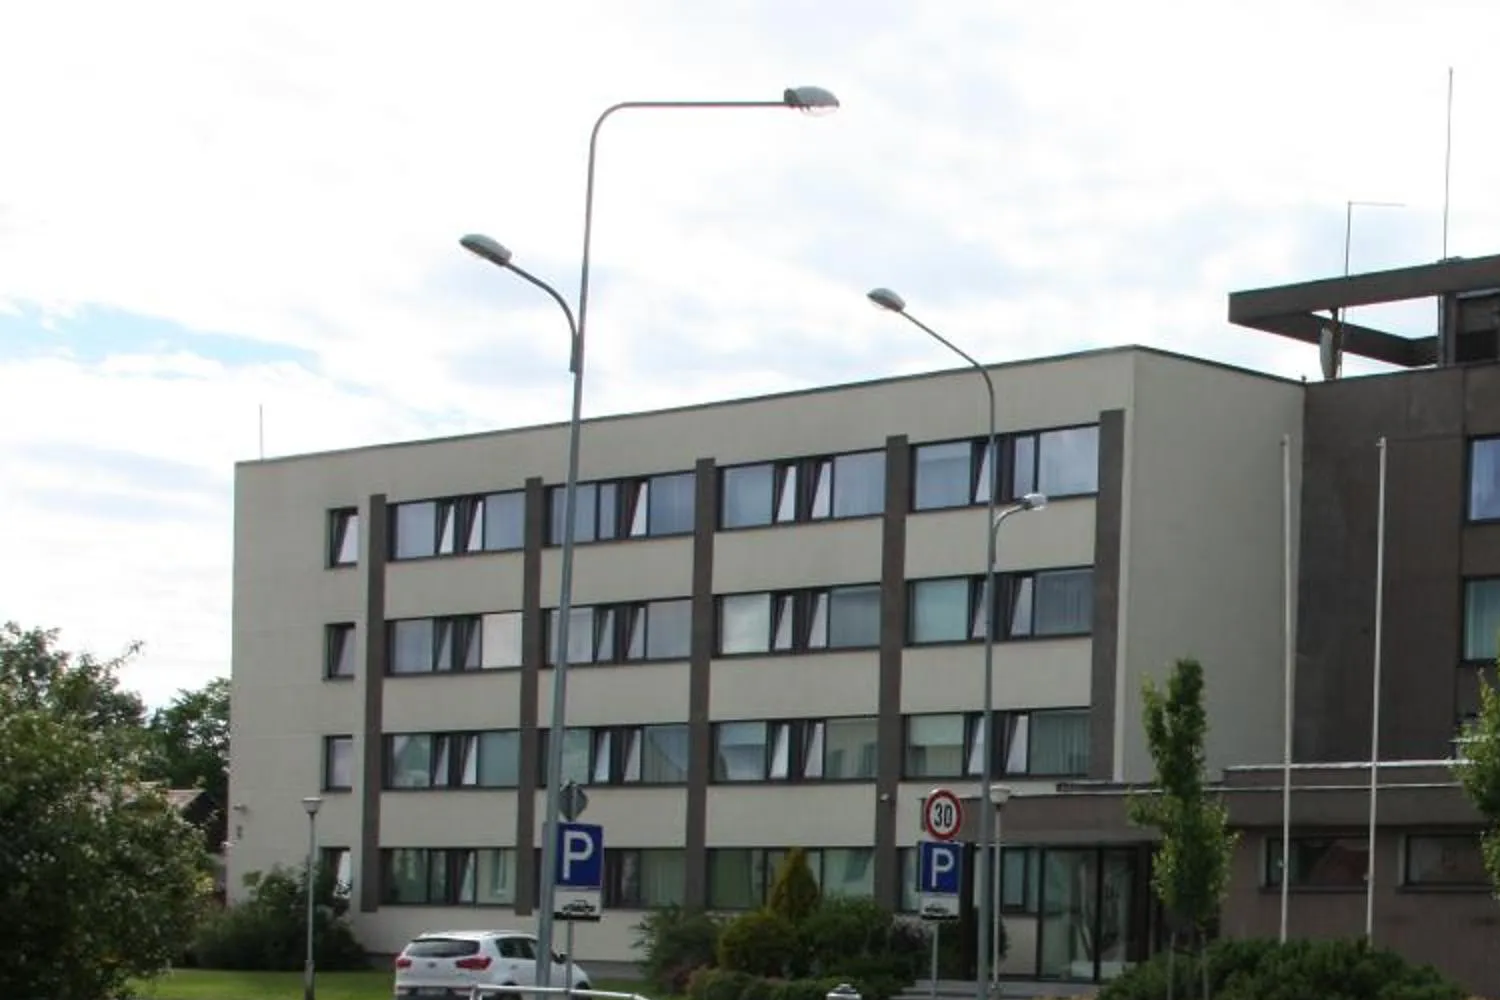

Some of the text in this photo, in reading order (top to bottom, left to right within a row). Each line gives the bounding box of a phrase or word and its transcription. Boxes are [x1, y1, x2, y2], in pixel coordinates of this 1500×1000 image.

[934, 804, 953, 828] 30
[563, 830, 593, 880] P
[931, 848, 954, 887] P
